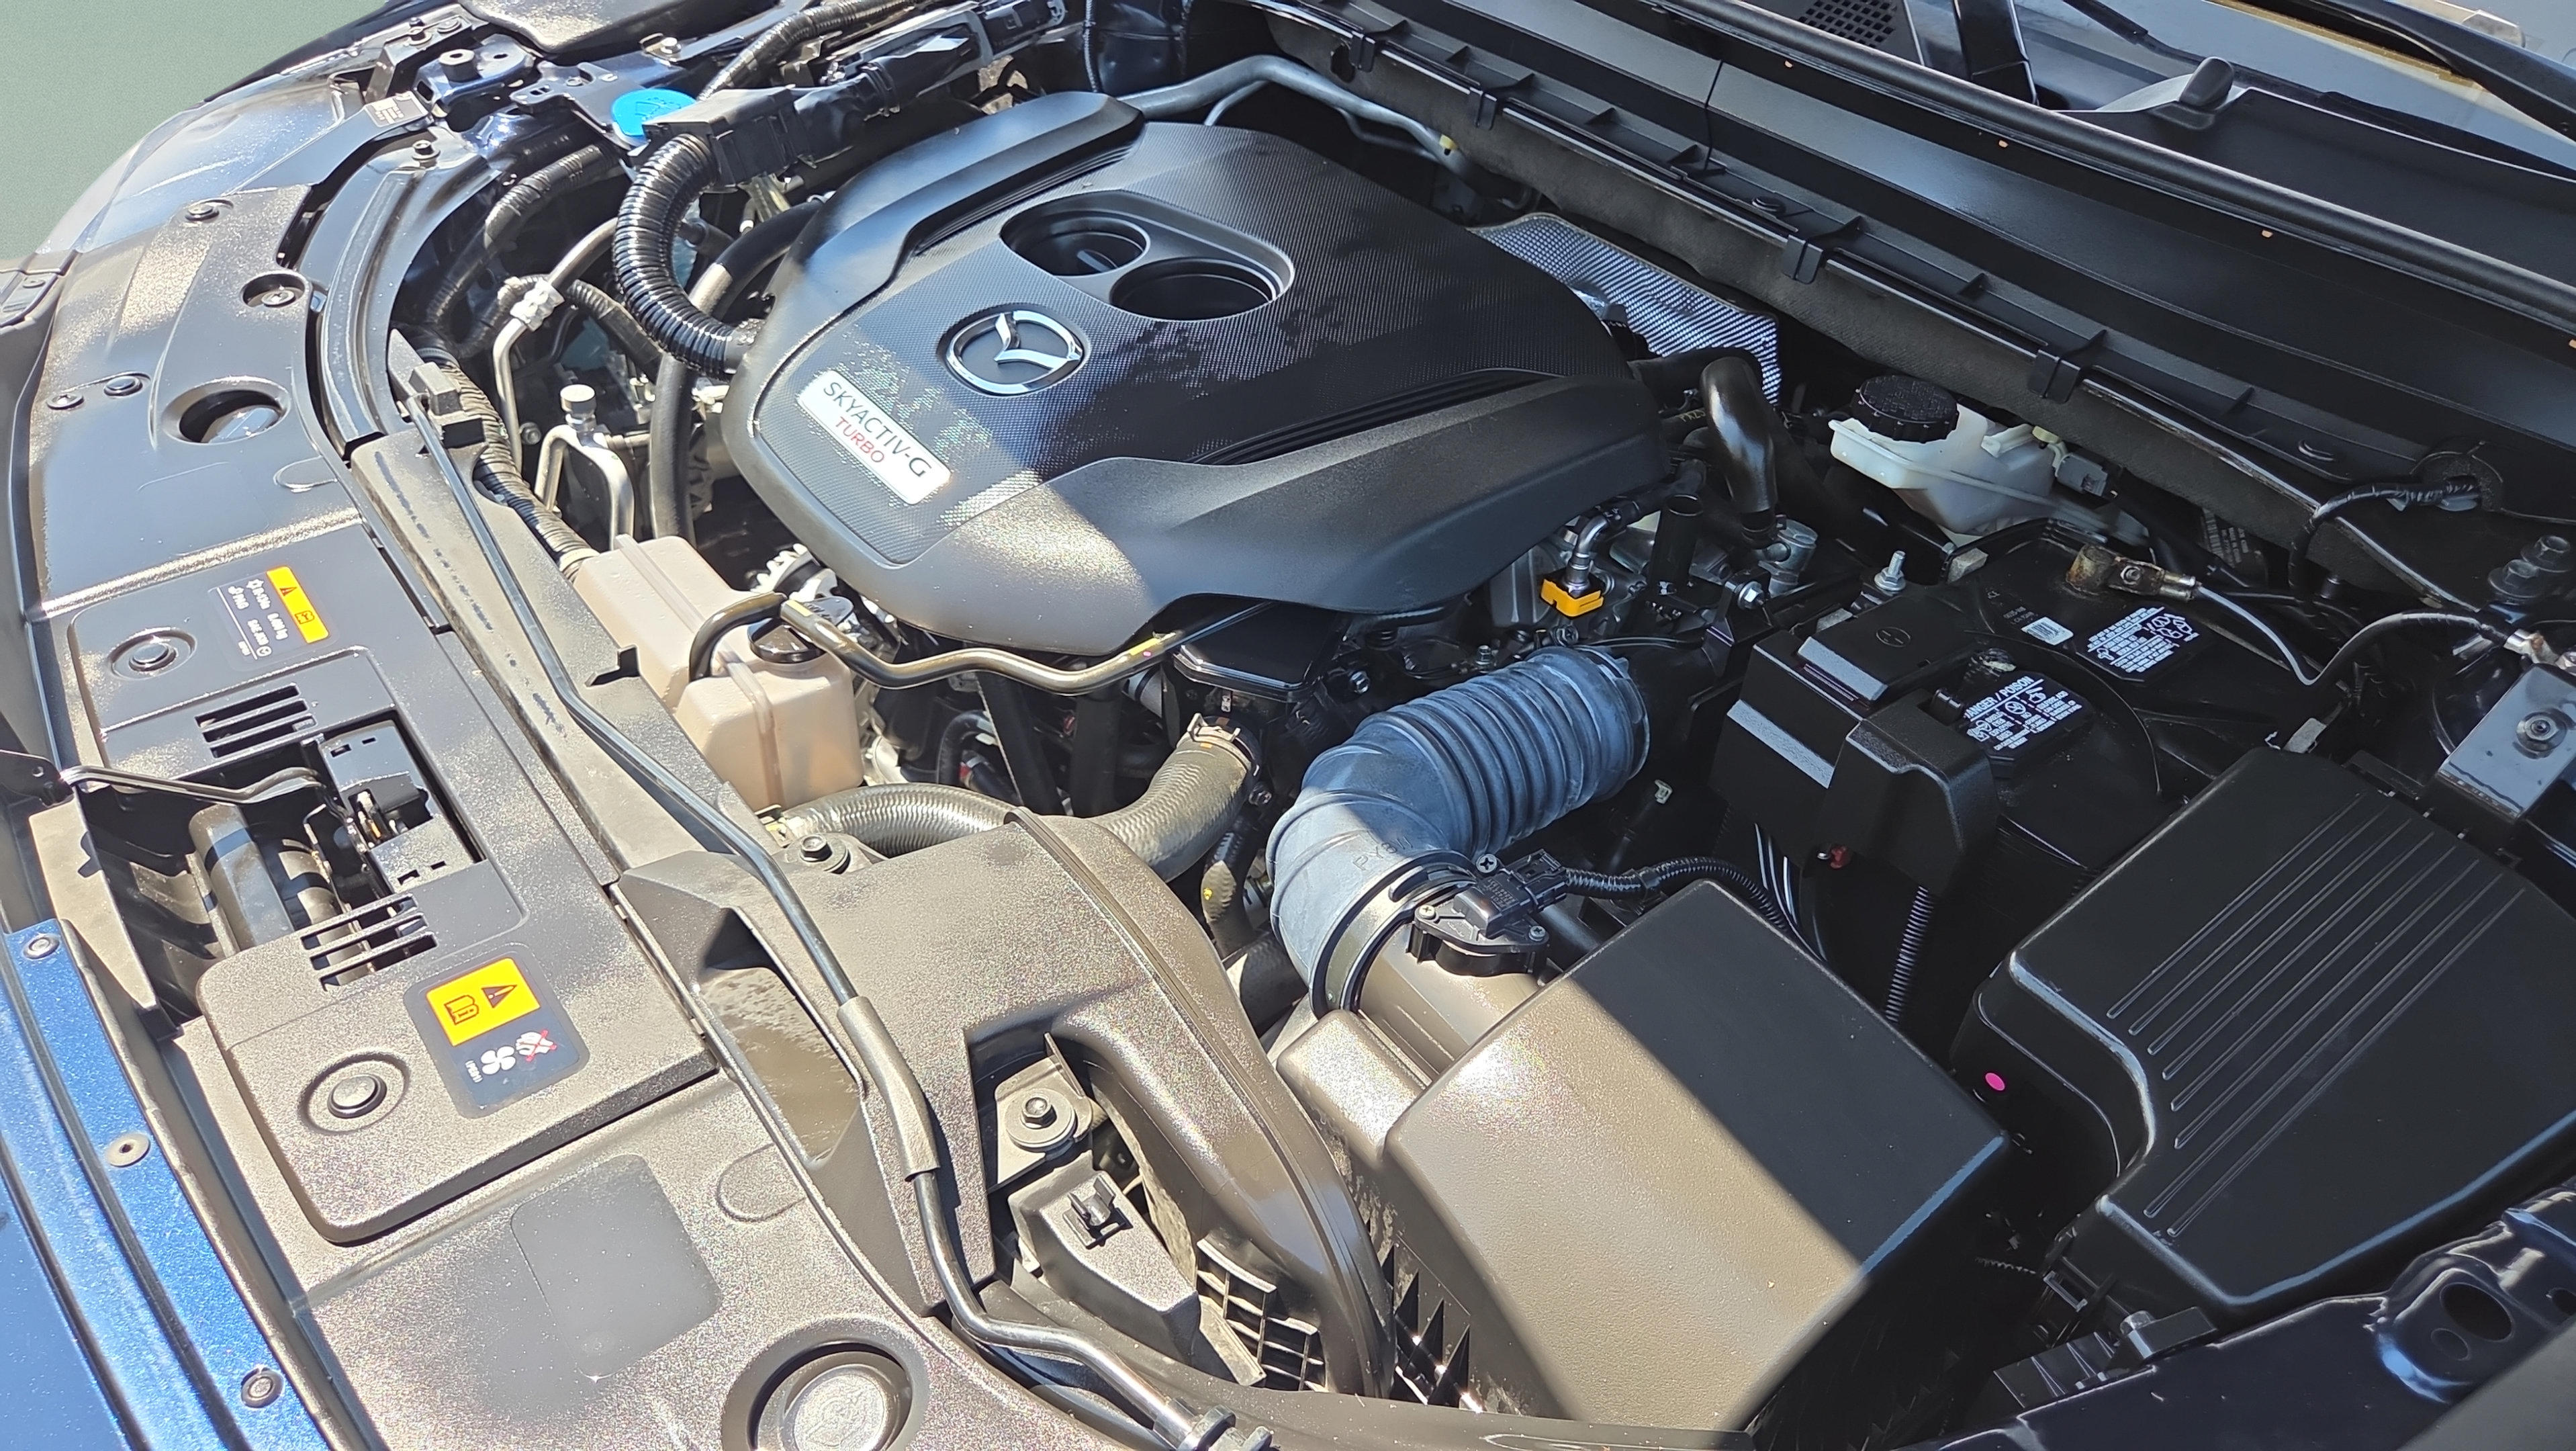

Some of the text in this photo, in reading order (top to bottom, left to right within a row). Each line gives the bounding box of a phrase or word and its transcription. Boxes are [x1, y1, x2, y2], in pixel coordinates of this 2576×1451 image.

[823, 382, 932, 478] SKYACTIV-G
[835, 416, 885, 464] TURBO
[232, 594, 249, 610] PAG
[2000, 675, 2035, 698] POISON
